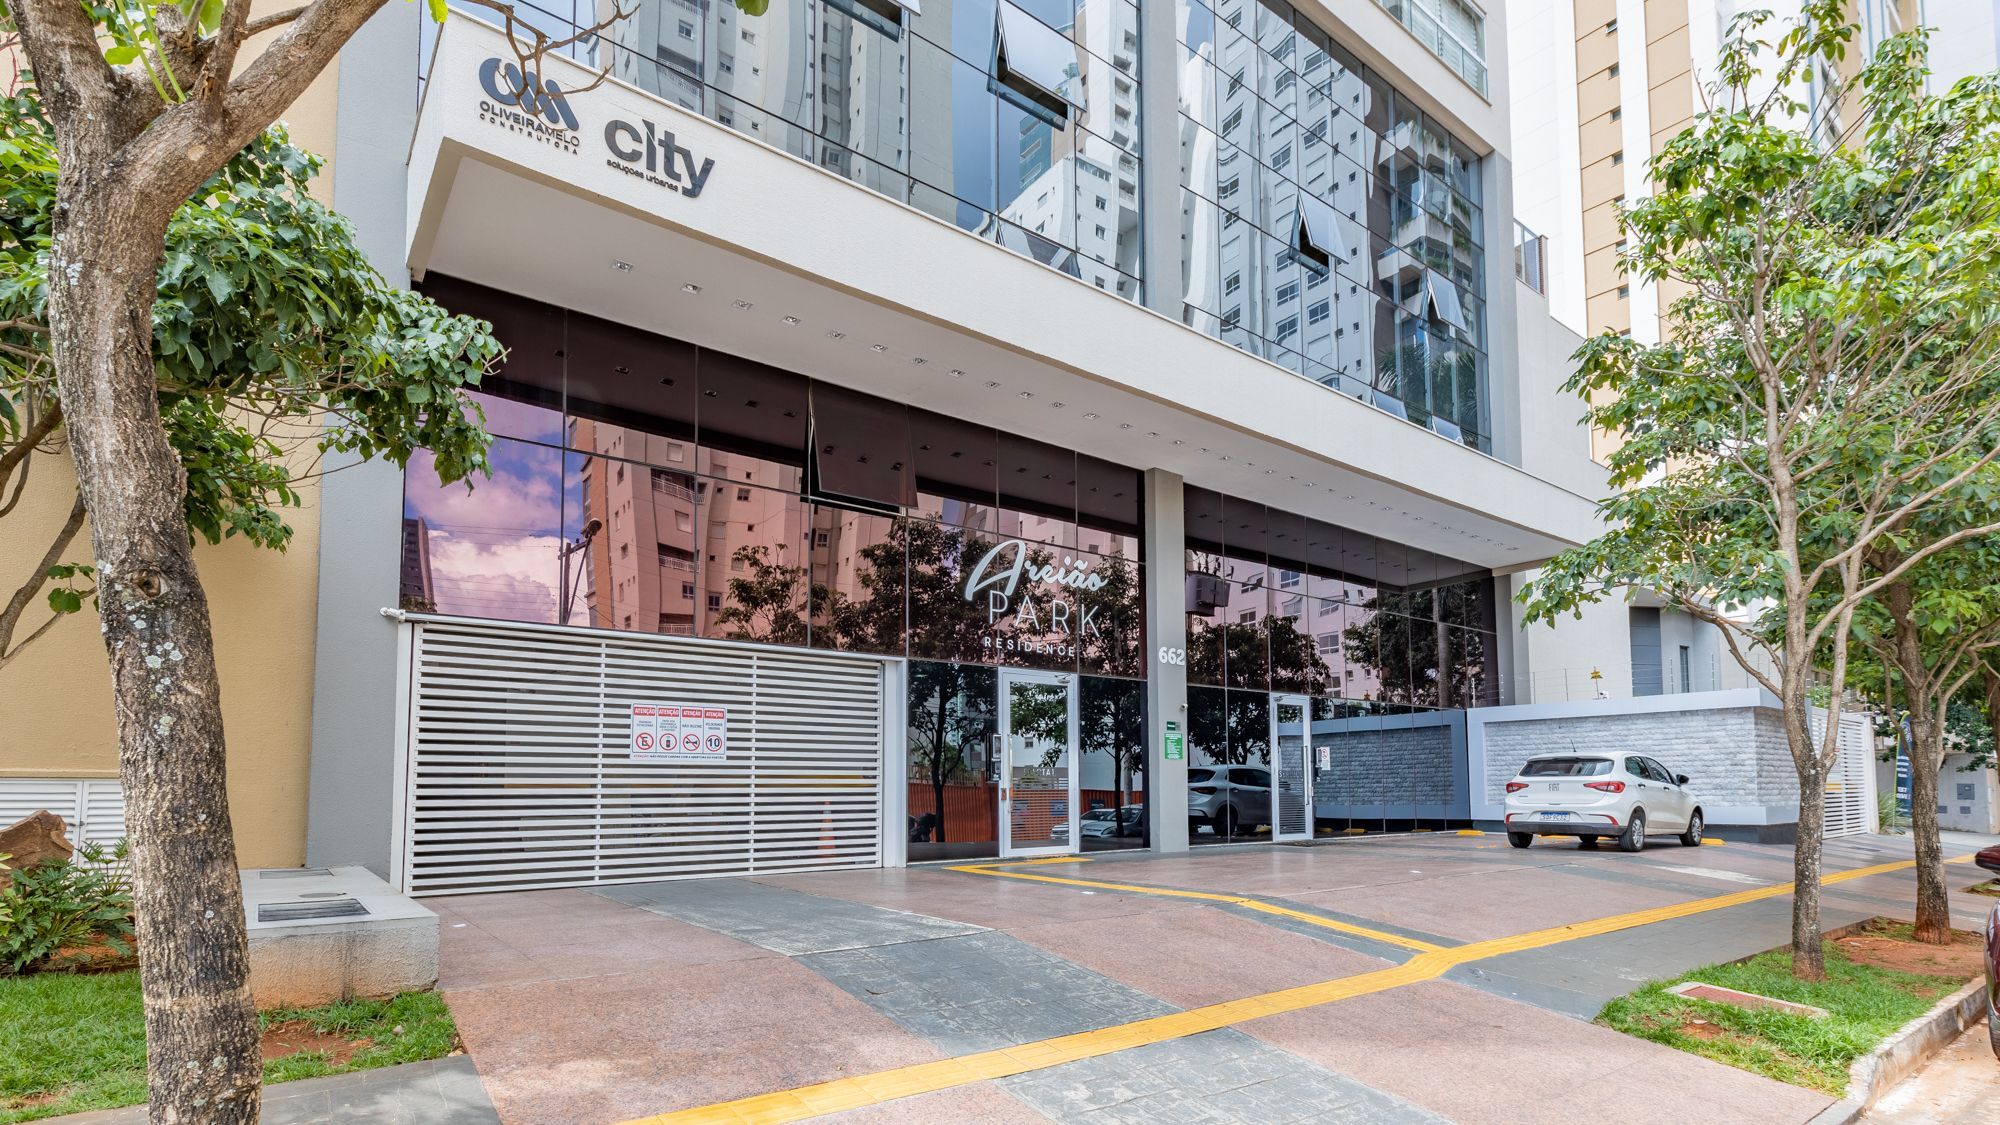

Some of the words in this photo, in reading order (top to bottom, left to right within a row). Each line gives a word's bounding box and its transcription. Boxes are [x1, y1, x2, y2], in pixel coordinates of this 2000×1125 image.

[479, 113, 578, 155] CONSTRUTORA
[604, 118, 716, 198] city
[645, 174, 679, 193] urbanas
[964, 540, 1109, 601] Areião
[988, 589, 1100, 638] PARK
[983, 636, 1076, 657] RESIDENCE
[1158, 646, 1186, 666] 662
[708, 738, 720, 748] 10
[1548, 783, 1560, 791] FIAT
